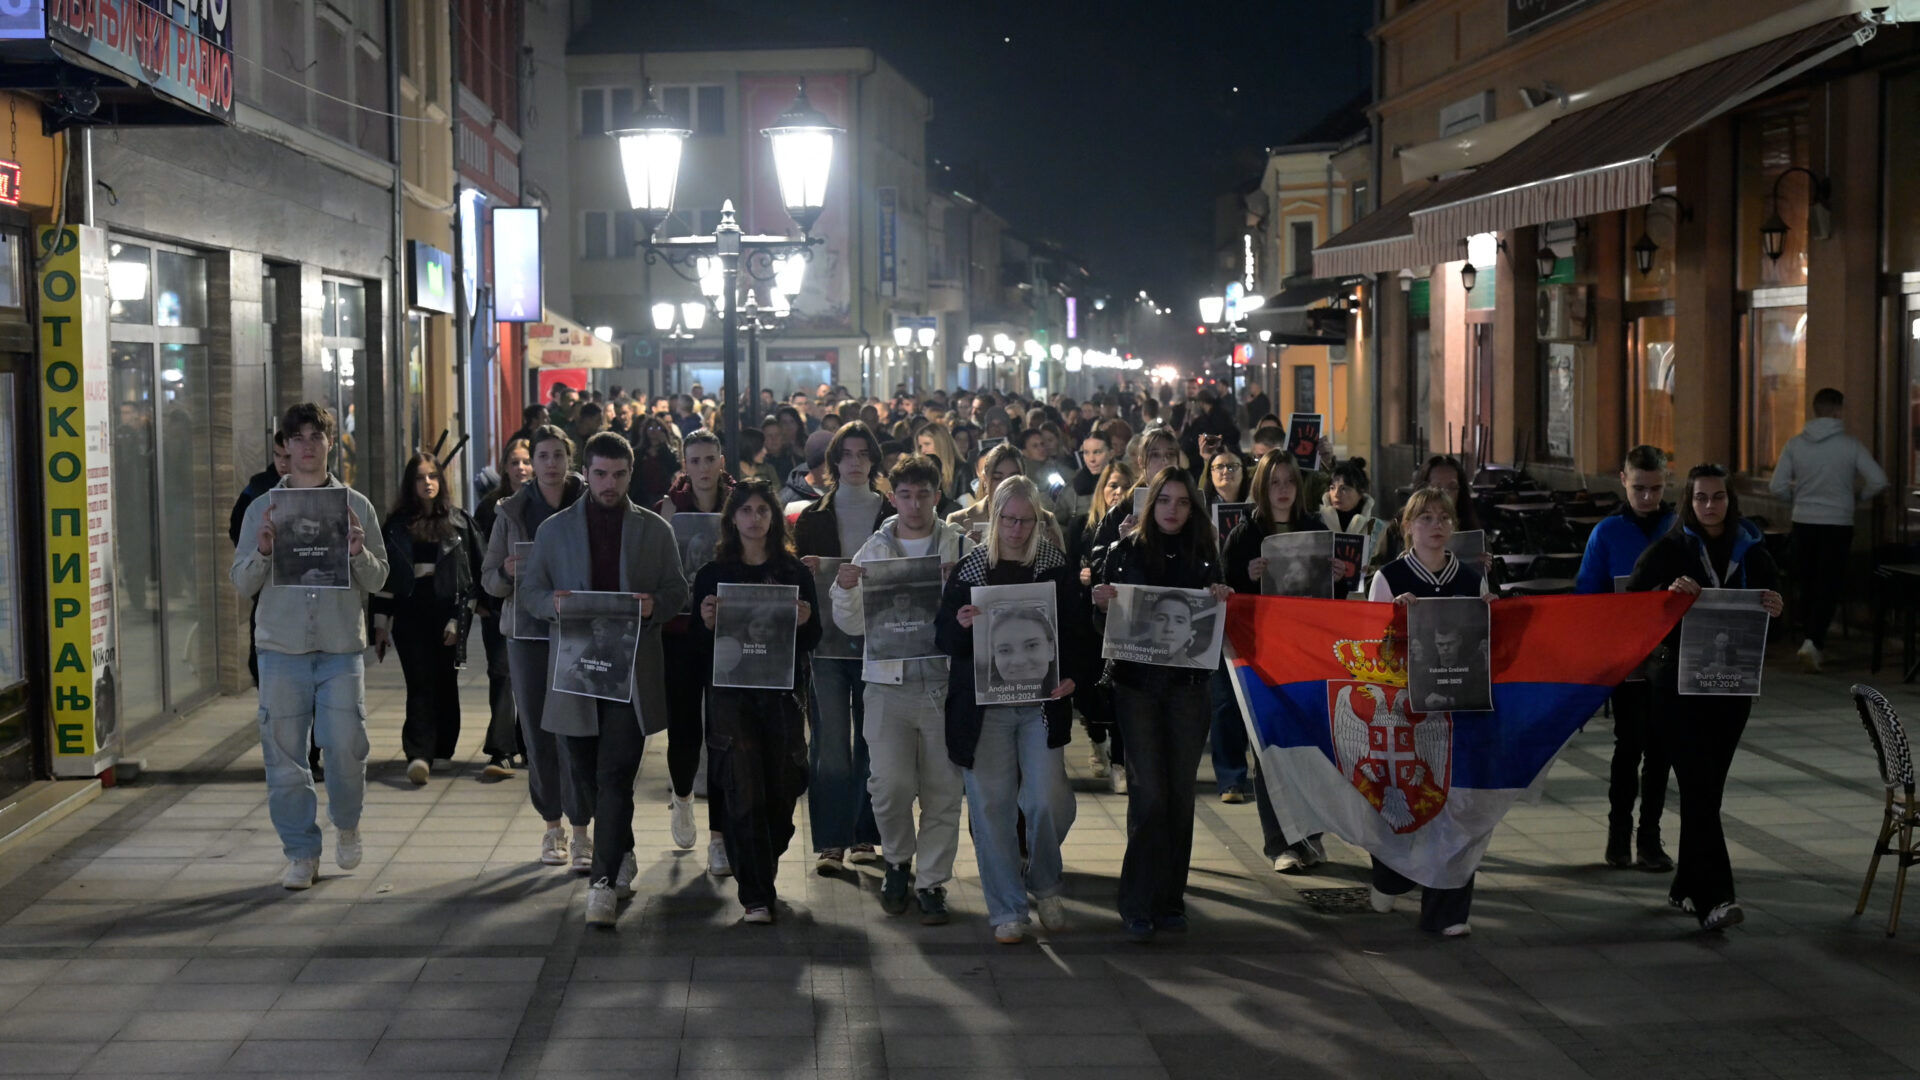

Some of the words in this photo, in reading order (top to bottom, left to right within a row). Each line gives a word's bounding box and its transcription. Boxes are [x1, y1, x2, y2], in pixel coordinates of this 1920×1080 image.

[177, 26, 232, 112] РАДИО
[92, 647, 115, 668] Nikon
[1115, 651, 1152, 662] 2003-2024
[988, 684, 1015, 694] Andjela
[1016, 683, 1042, 691] Ruman
[1700, 680, 1740, 688] 1947-2024
[997, 692, 1036, 701] 2004-2024
